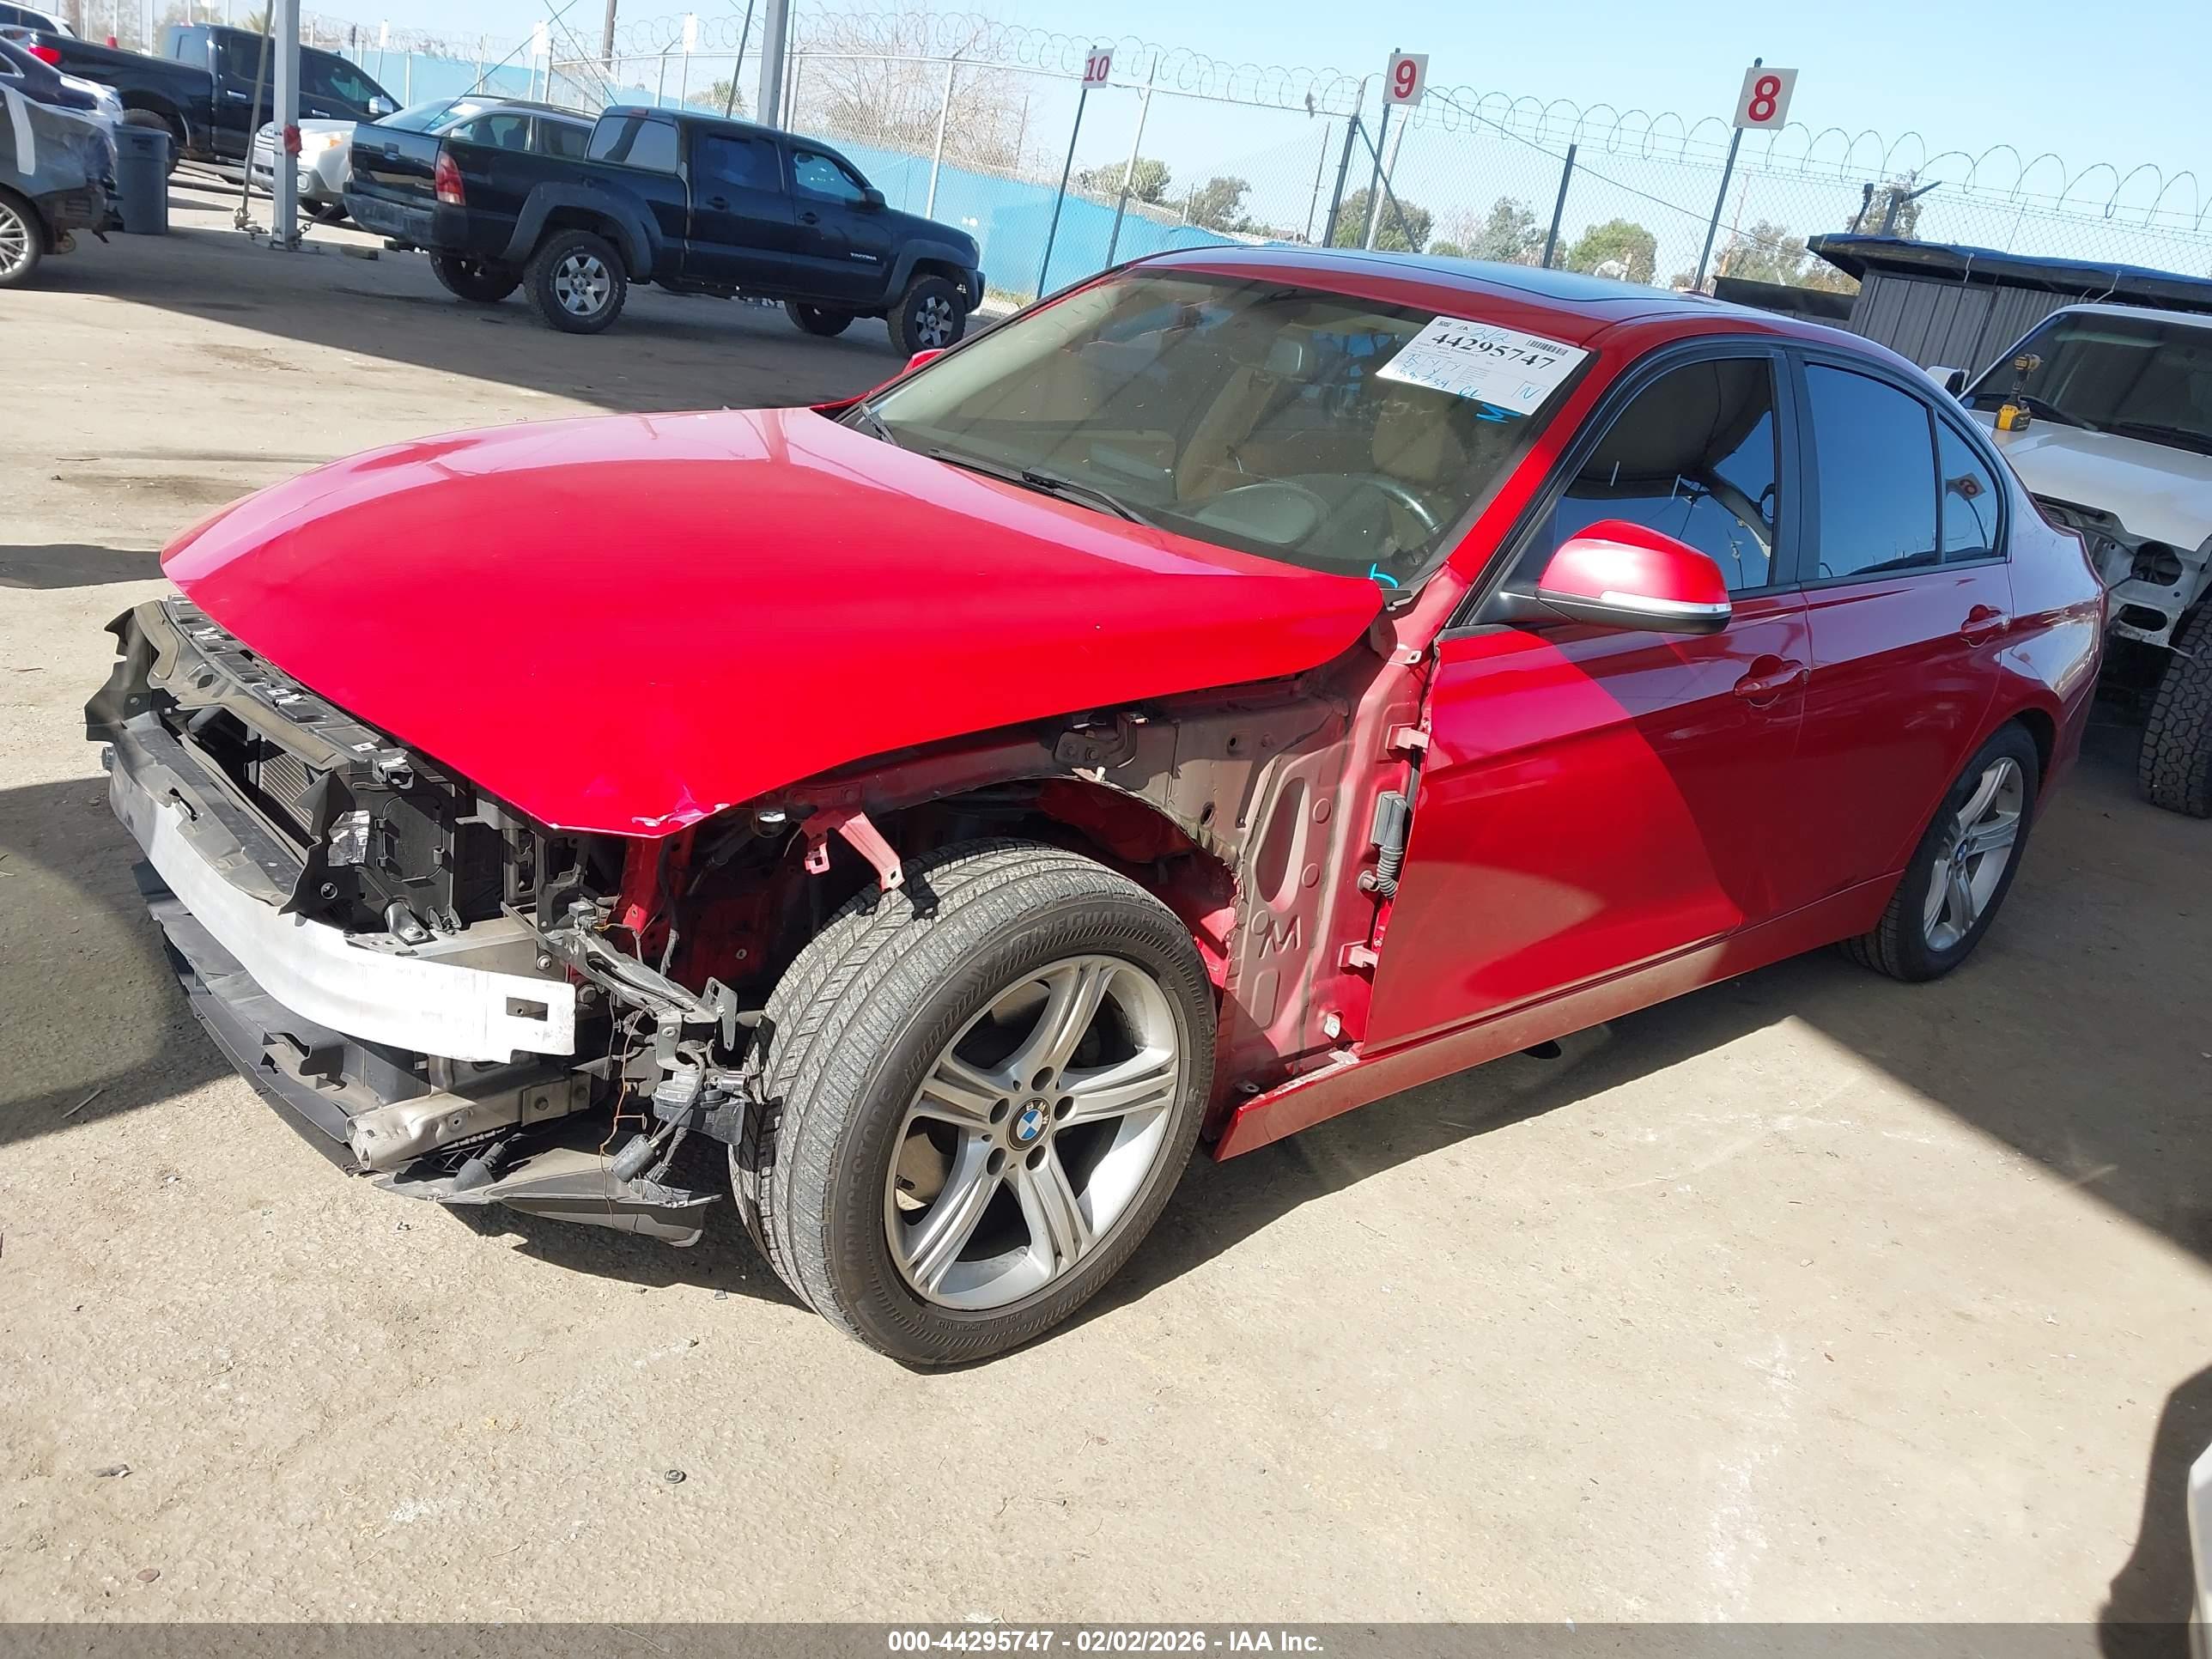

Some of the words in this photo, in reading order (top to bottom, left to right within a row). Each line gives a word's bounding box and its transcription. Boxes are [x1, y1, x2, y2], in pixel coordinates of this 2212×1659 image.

[1084, 56, 1109, 82] 10
[1395, 59, 1417, 99] 9
[1748, 75, 1781, 122] 8
[1431, 333, 1557, 370] 44295747
[1026, 1101, 1049, 1125] BMW
